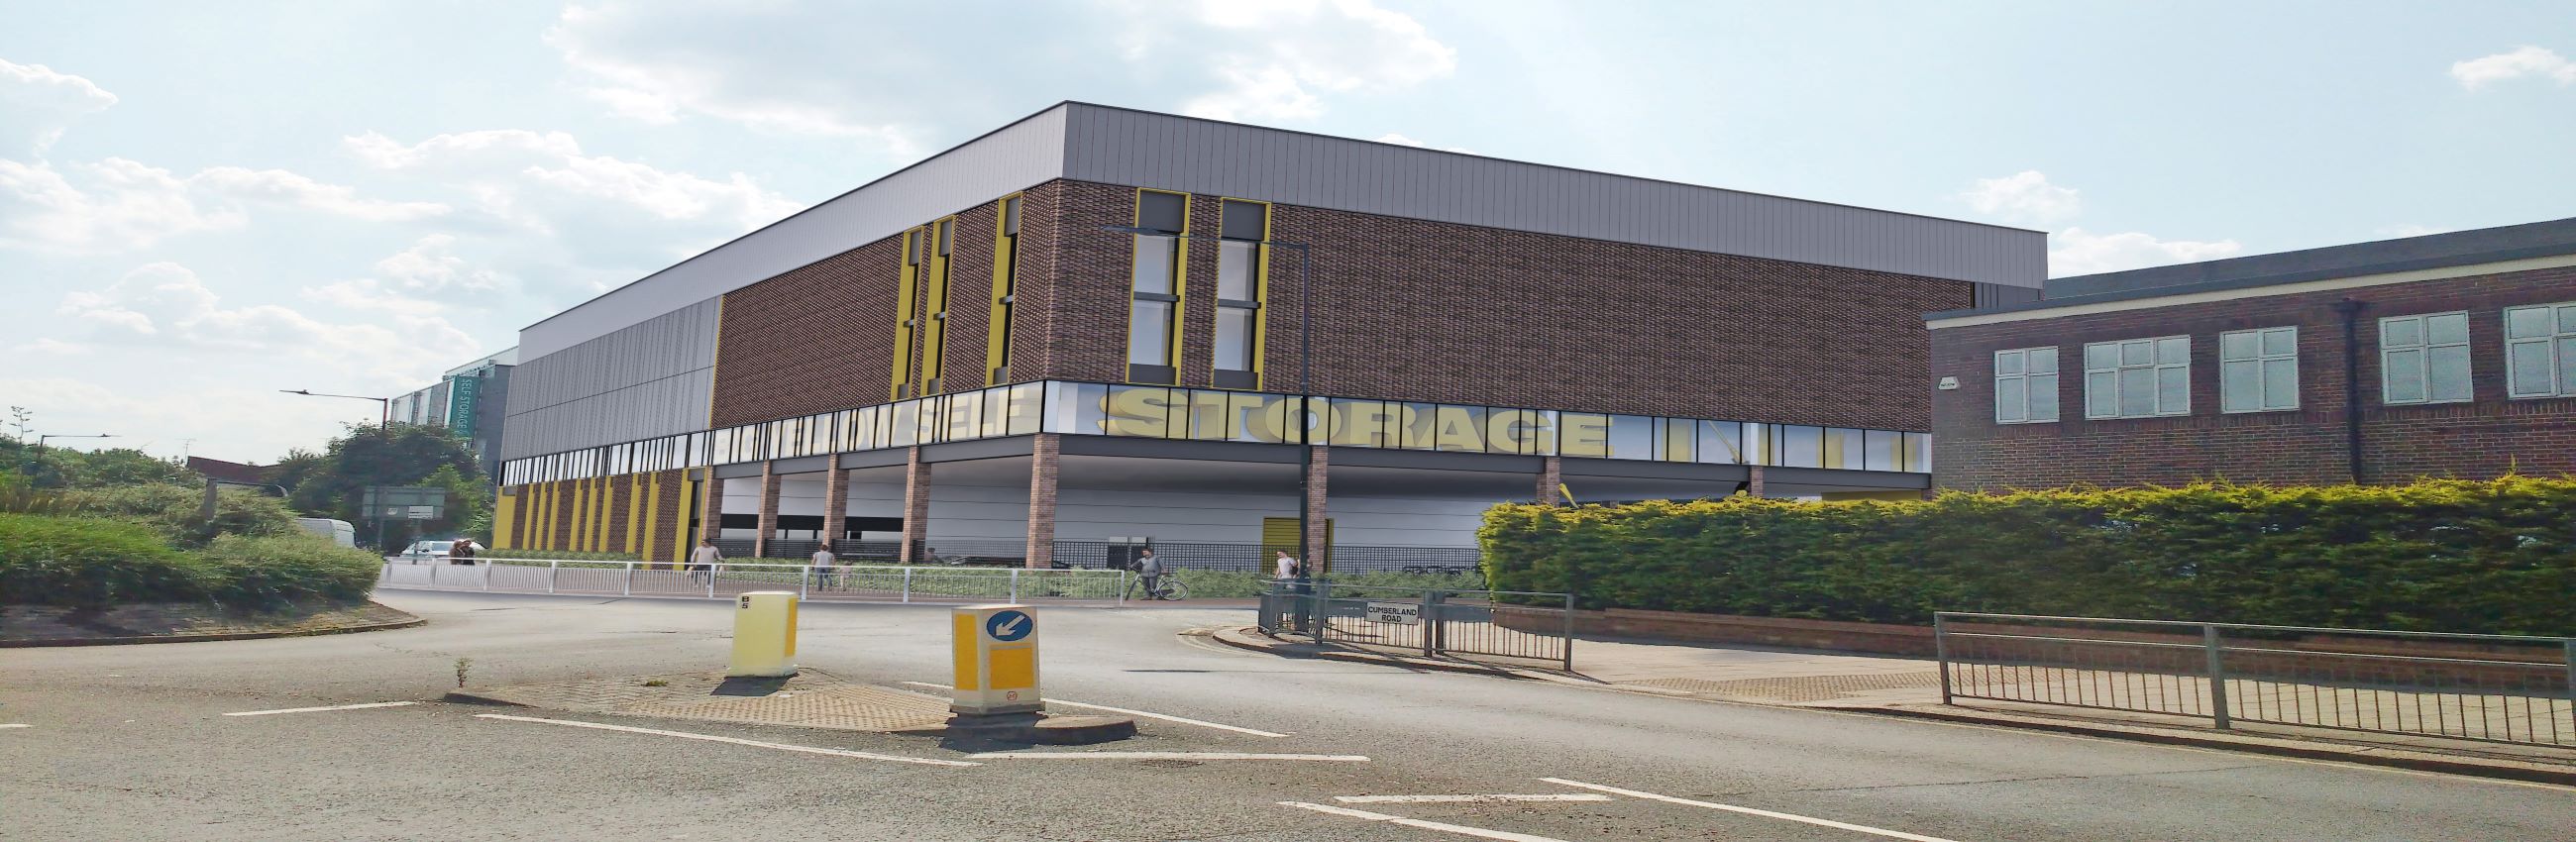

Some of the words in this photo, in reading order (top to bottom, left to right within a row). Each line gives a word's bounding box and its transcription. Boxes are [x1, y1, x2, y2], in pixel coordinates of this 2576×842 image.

[461, 379, 472, 395] SELF
[458, 396, 470, 428] STORAGE
[766, 405, 903, 460] YELLOW
[912, 386, 1024, 445] SELF
[1097, 388, 1614, 457] STORAGE
[1368, 606, 1417, 616] CUMBERLAND
